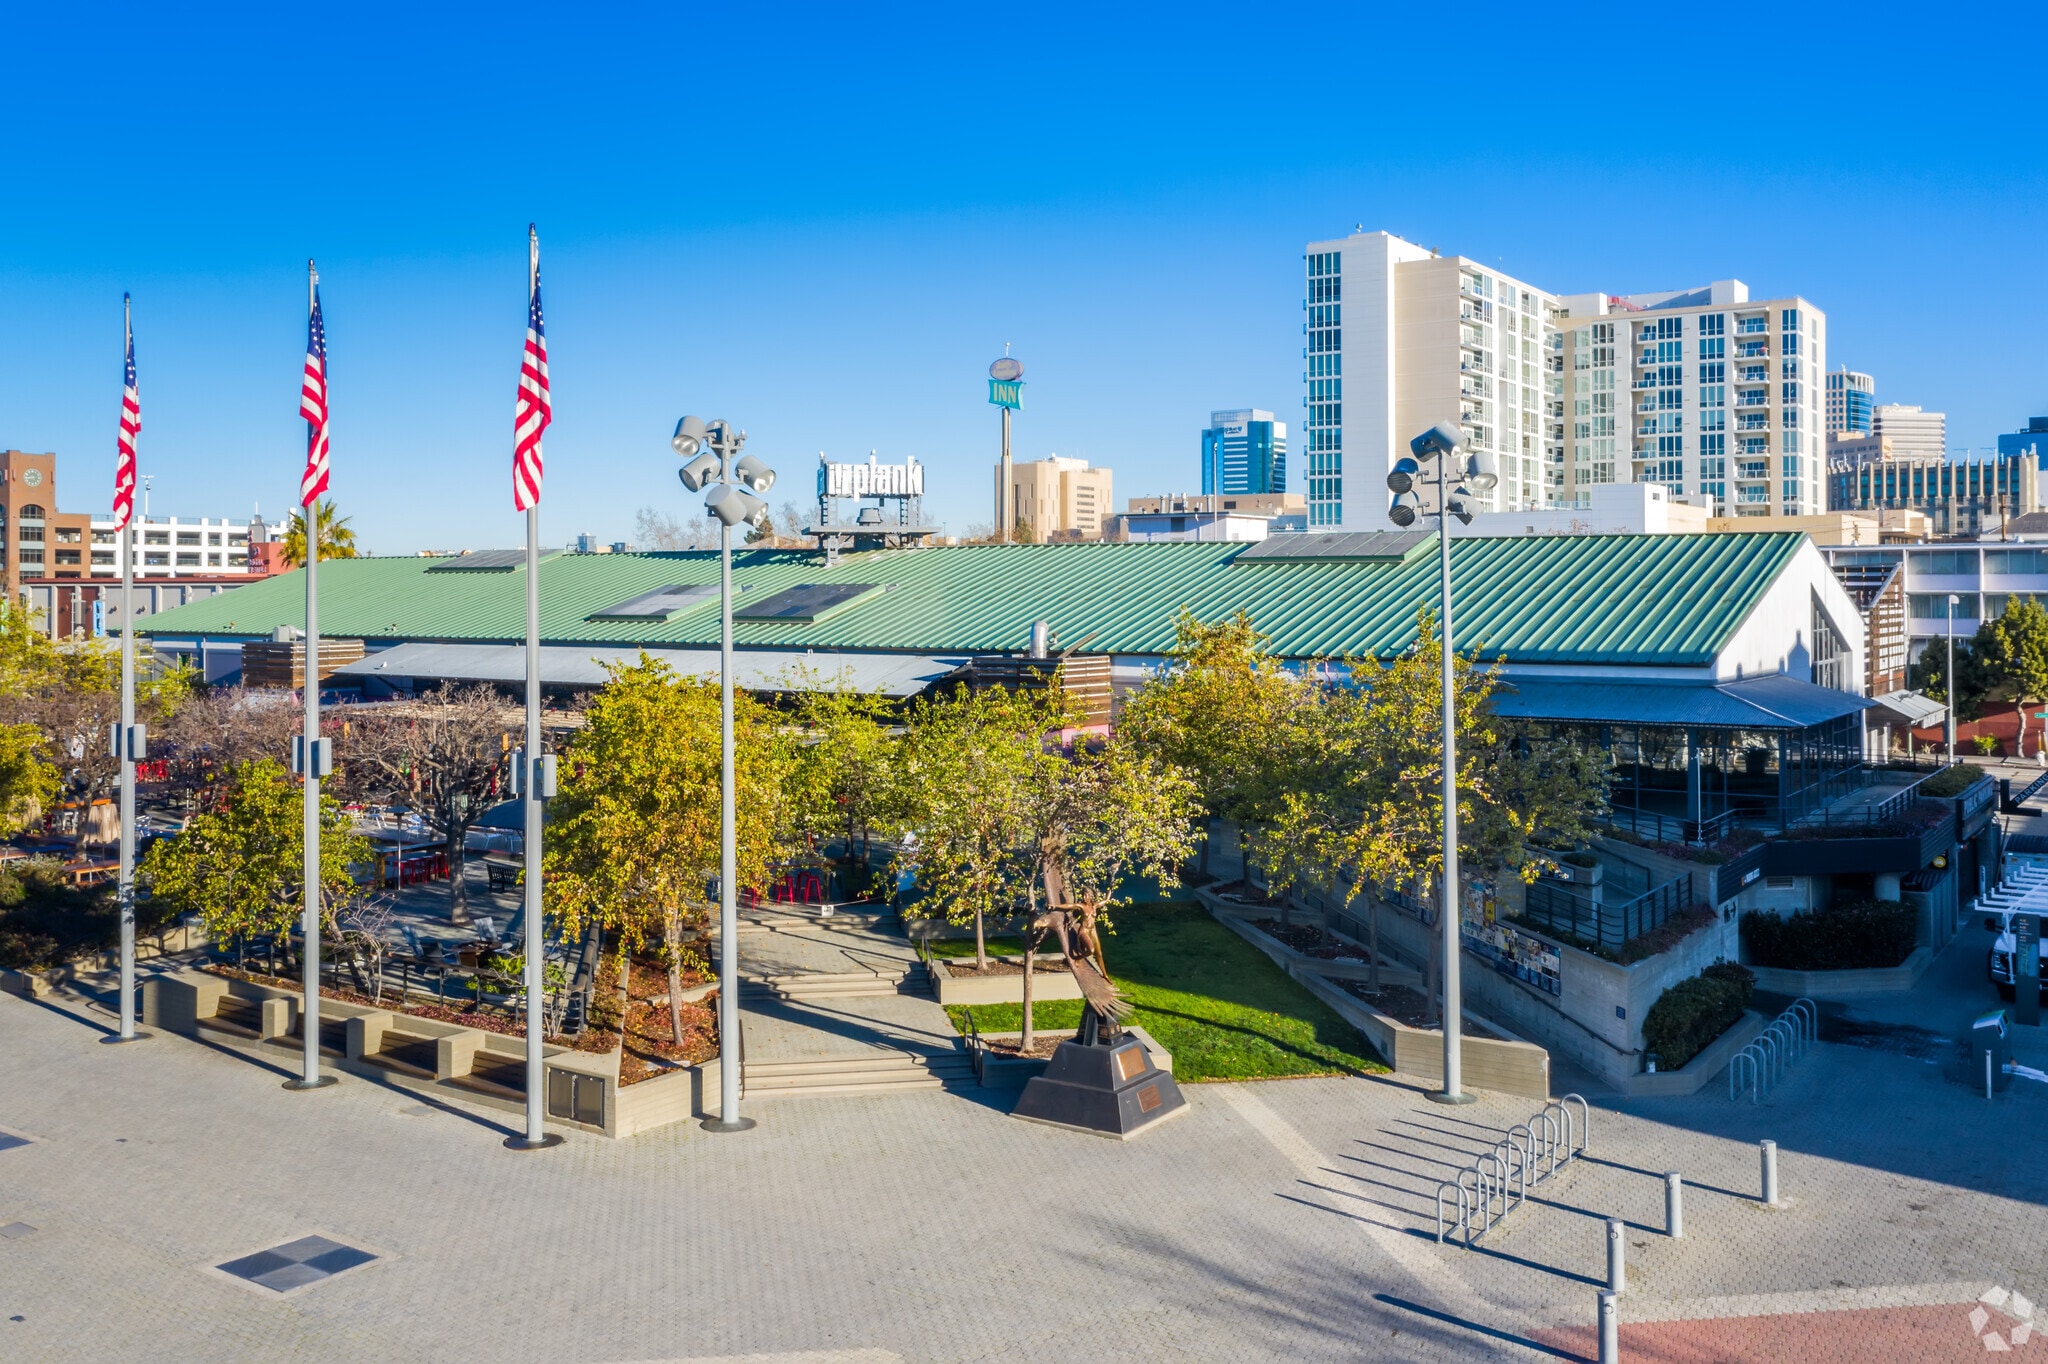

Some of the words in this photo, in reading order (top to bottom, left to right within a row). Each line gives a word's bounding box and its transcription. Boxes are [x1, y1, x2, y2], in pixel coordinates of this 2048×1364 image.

[993, 383, 1017, 404] INN
[853, 455, 924, 503] plank
[2014, 775, 2048, 803] PARKING
